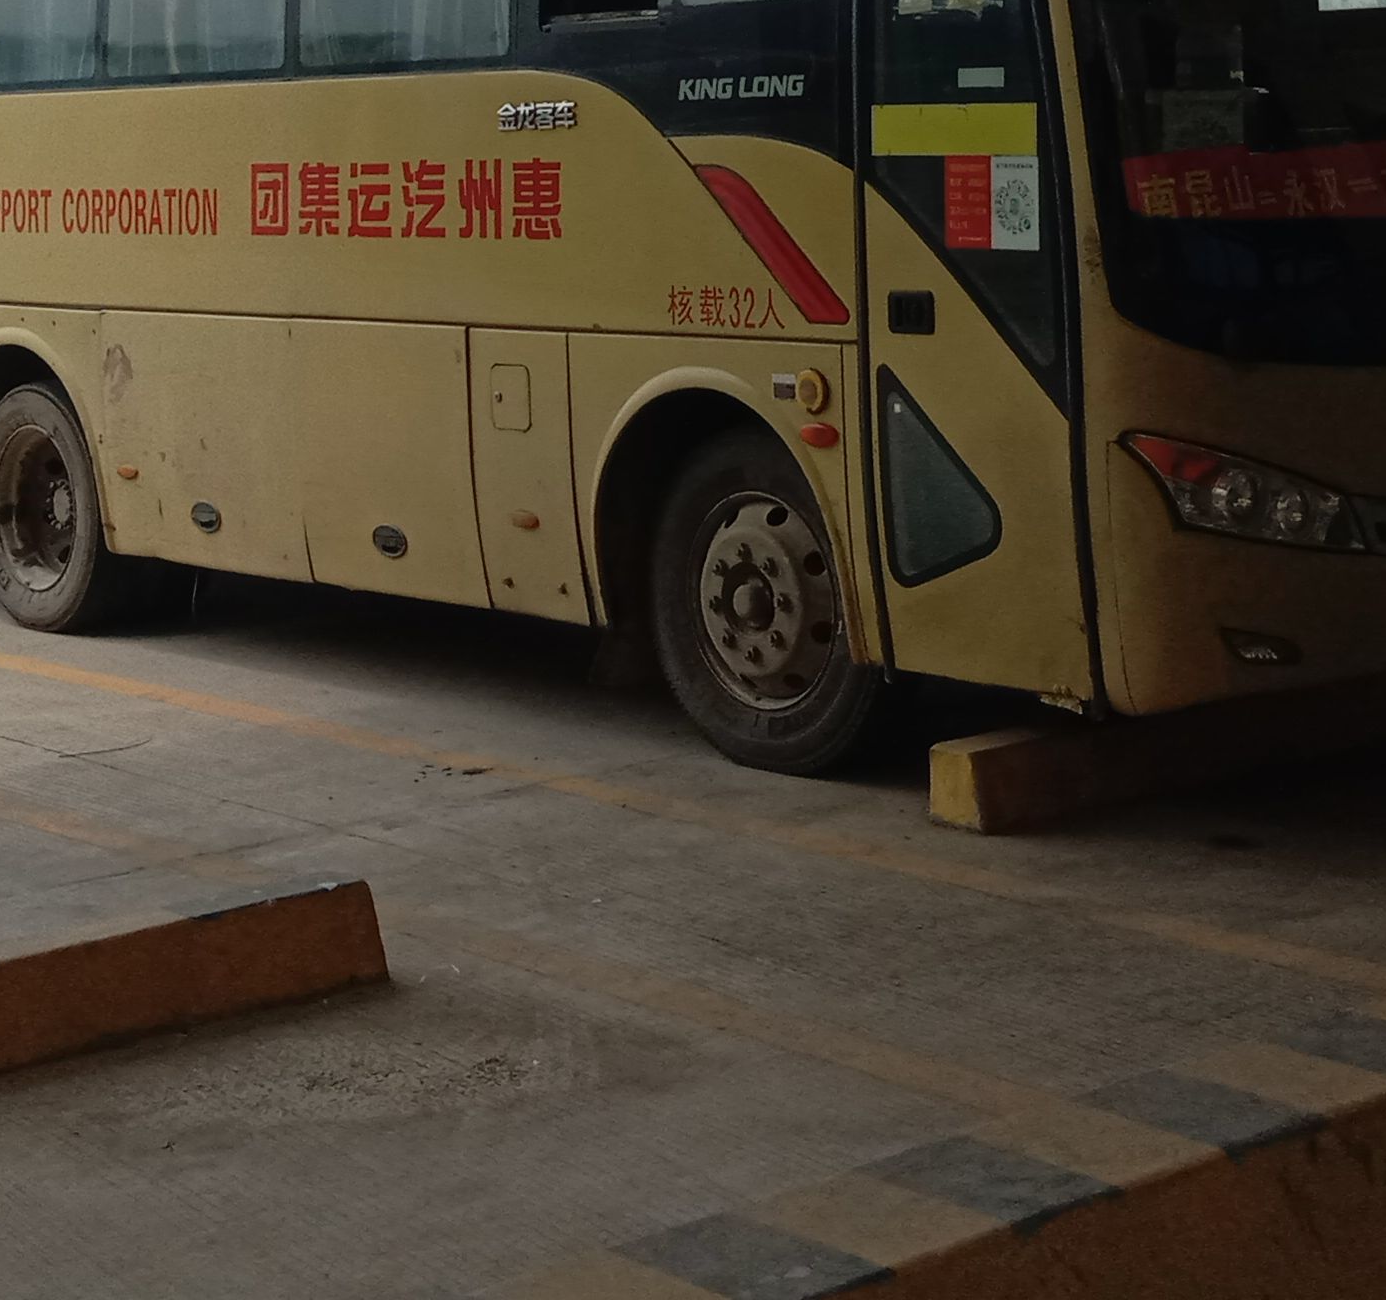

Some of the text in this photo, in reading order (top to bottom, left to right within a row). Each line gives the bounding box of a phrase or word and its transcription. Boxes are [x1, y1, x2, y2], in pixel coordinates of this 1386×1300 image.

[678, 74, 805, 101] KING LONG
[497, 101, 578, 131] 金龙客车
[61, 186, 219, 237] CORPORATION
[668, 284, 786, 329] 核载32人
